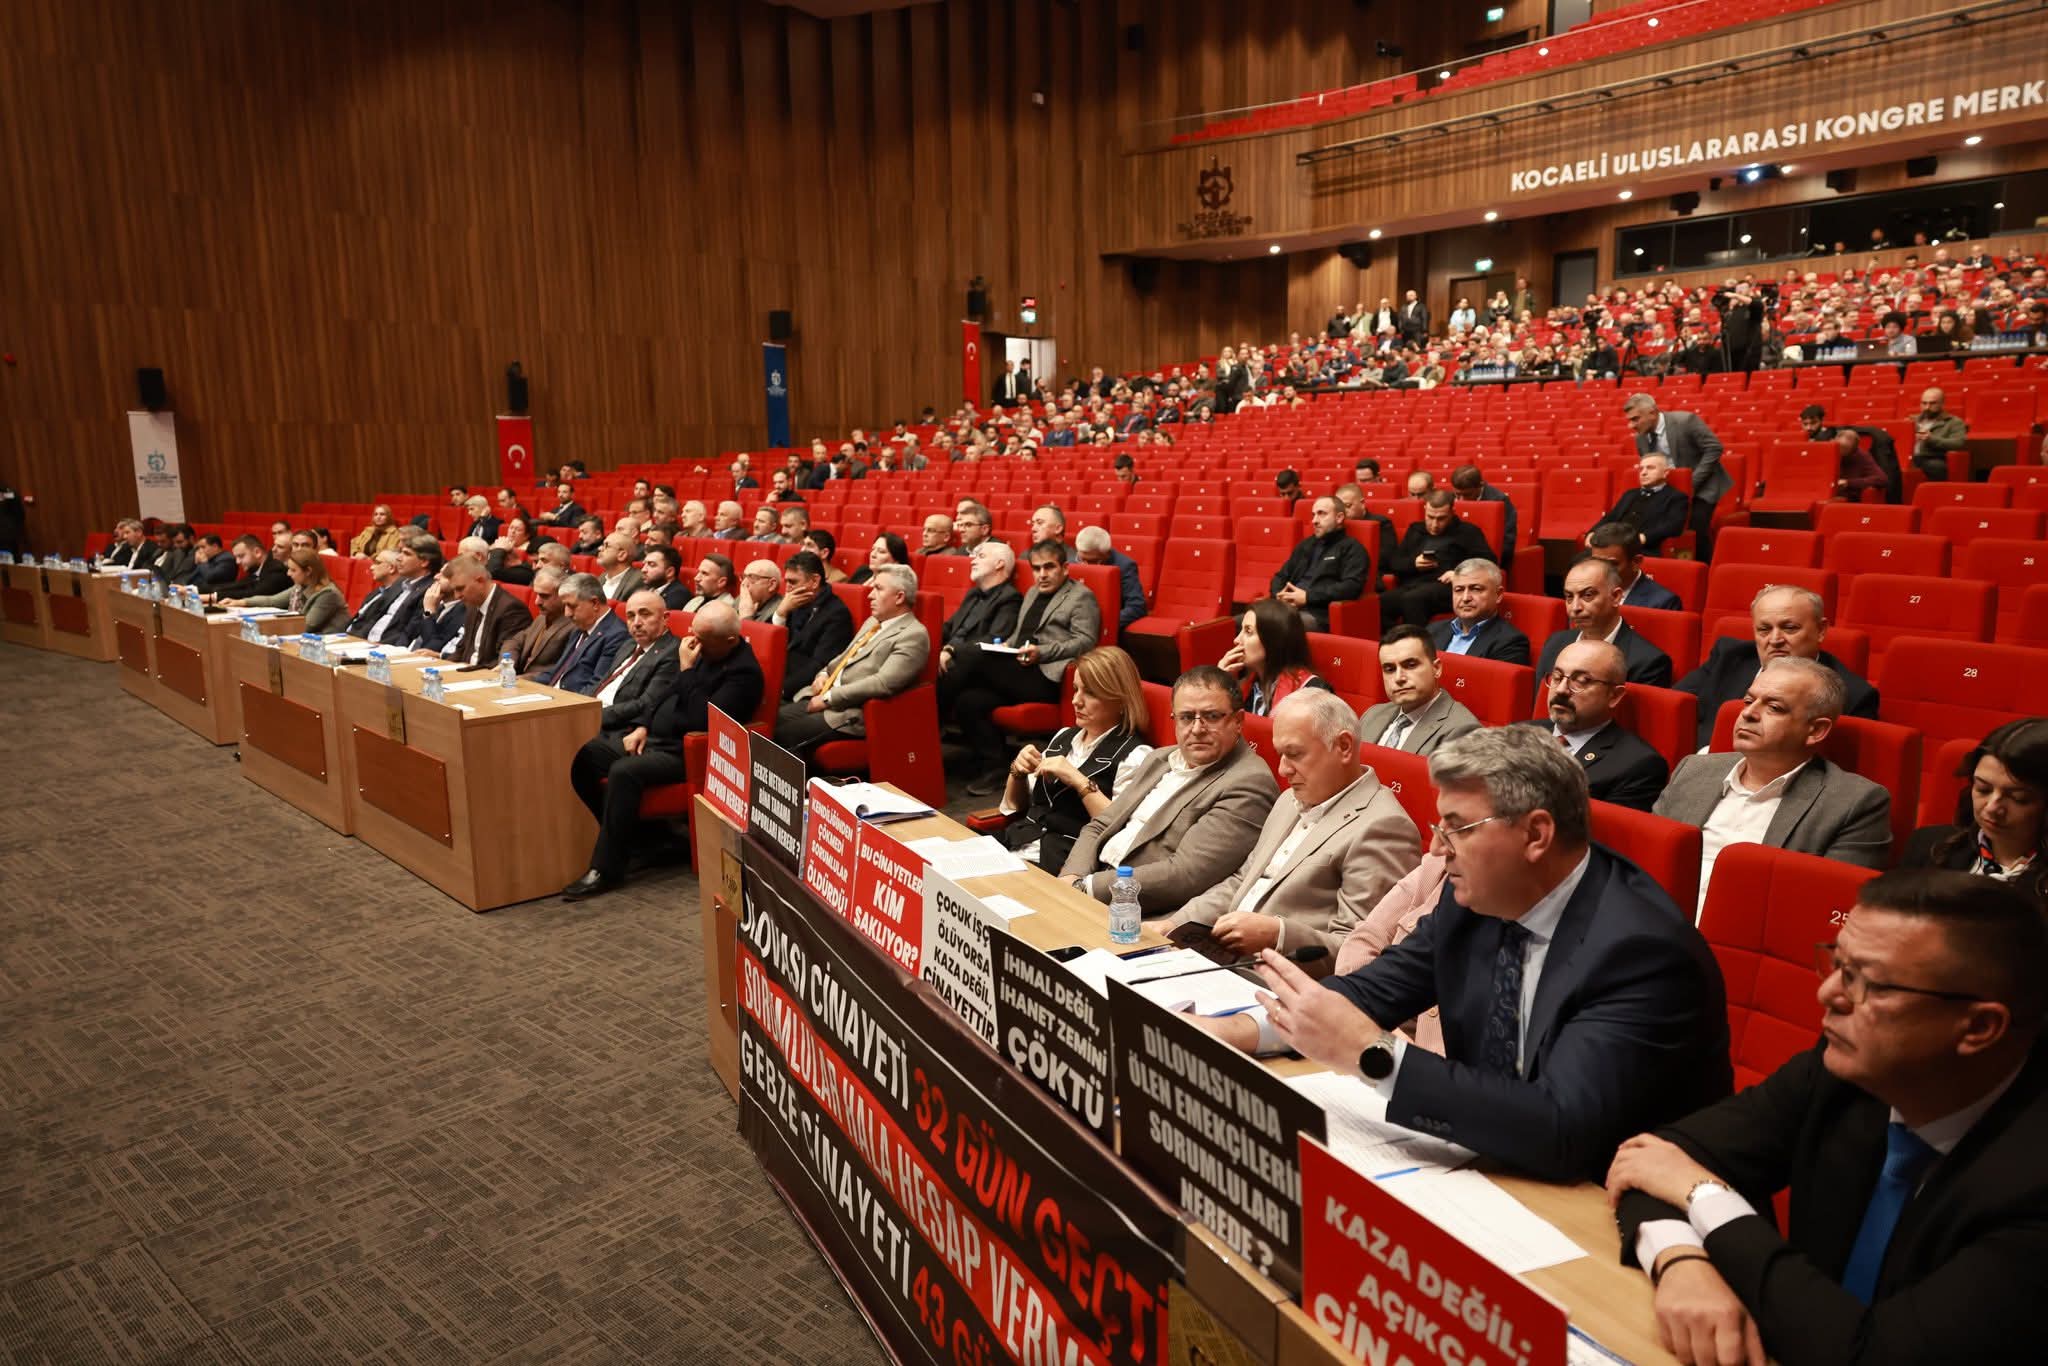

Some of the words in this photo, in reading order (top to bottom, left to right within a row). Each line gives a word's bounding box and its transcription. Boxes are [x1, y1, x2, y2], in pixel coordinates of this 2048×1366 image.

[1511, 152, 1608, 192] KOCAELİ
[1613, 125, 1808, 177] ULUSLARARASI
[1814, 97, 1945, 143] KONGRE
[1952, 80, 2048, 120] MERK
[1909, 595, 1921, 603] 27
[1455, 677, 1465, 688] 25
[1963, 667, 1978, 678] 28
[1391, 781, 1402, 793] 23
[811, 839, 849, 883] SORUMLULAR
[817, 823, 845, 857] ÇÖKMEDİ
[861, 843, 873, 864] BU
[872, 849, 924, 897] CİNAYETLER
[806, 859, 849, 917] ÖLDÜRDÜ!
[872, 879, 905, 924] KİM
[936, 890, 971, 930] ÇOCUK
[972, 911, 991, 948] İŞÇ
[853, 905, 919, 970] SAKLIYOR?
[937, 918, 990, 977] ÖLÜYORSA
[923, 966, 995, 1045] CİNAYETTİR
[934, 946, 961, 981] KAZA
[961, 969, 993, 1011] DEĞİL,
[1003, 946, 1053, 996] İHMAL
[1055, 983, 1101, 1037] DEĞİL,
[999, 976, 1055, 1032] İHANET
[1056, 1018, 1108, 1077] ZEMİNİ
[810, 961, 909, 1111] CİNAYETİ
[914, 1067, 949, 1155] 32
[954, 1113, 1031, 1240] GÜN
[1007, 1026, 1104, 1129] ÇÖKTÜ
[1128, 1048, 1173, 1112] ÖLEN
[1143, 1023, 1283, 1144] DİLOVASI'NDA
[741, 1029, 799, 1137] GEBZE
[801, 1109, 911, 1301] CİNAYETİ
[912, 1265, 945, 1348] 43
[1149, 1109, 1289, 1245] SORUMLULARI
[842, 1075, 895, 1196] HALA
[897, 1143, 981, 1289] HESAP
[988, 1240, 1095, 1366] VERM
[1325, 1196, 1412, 1283] KAZA
[1314, 1292, 1415, 1366] CİN
